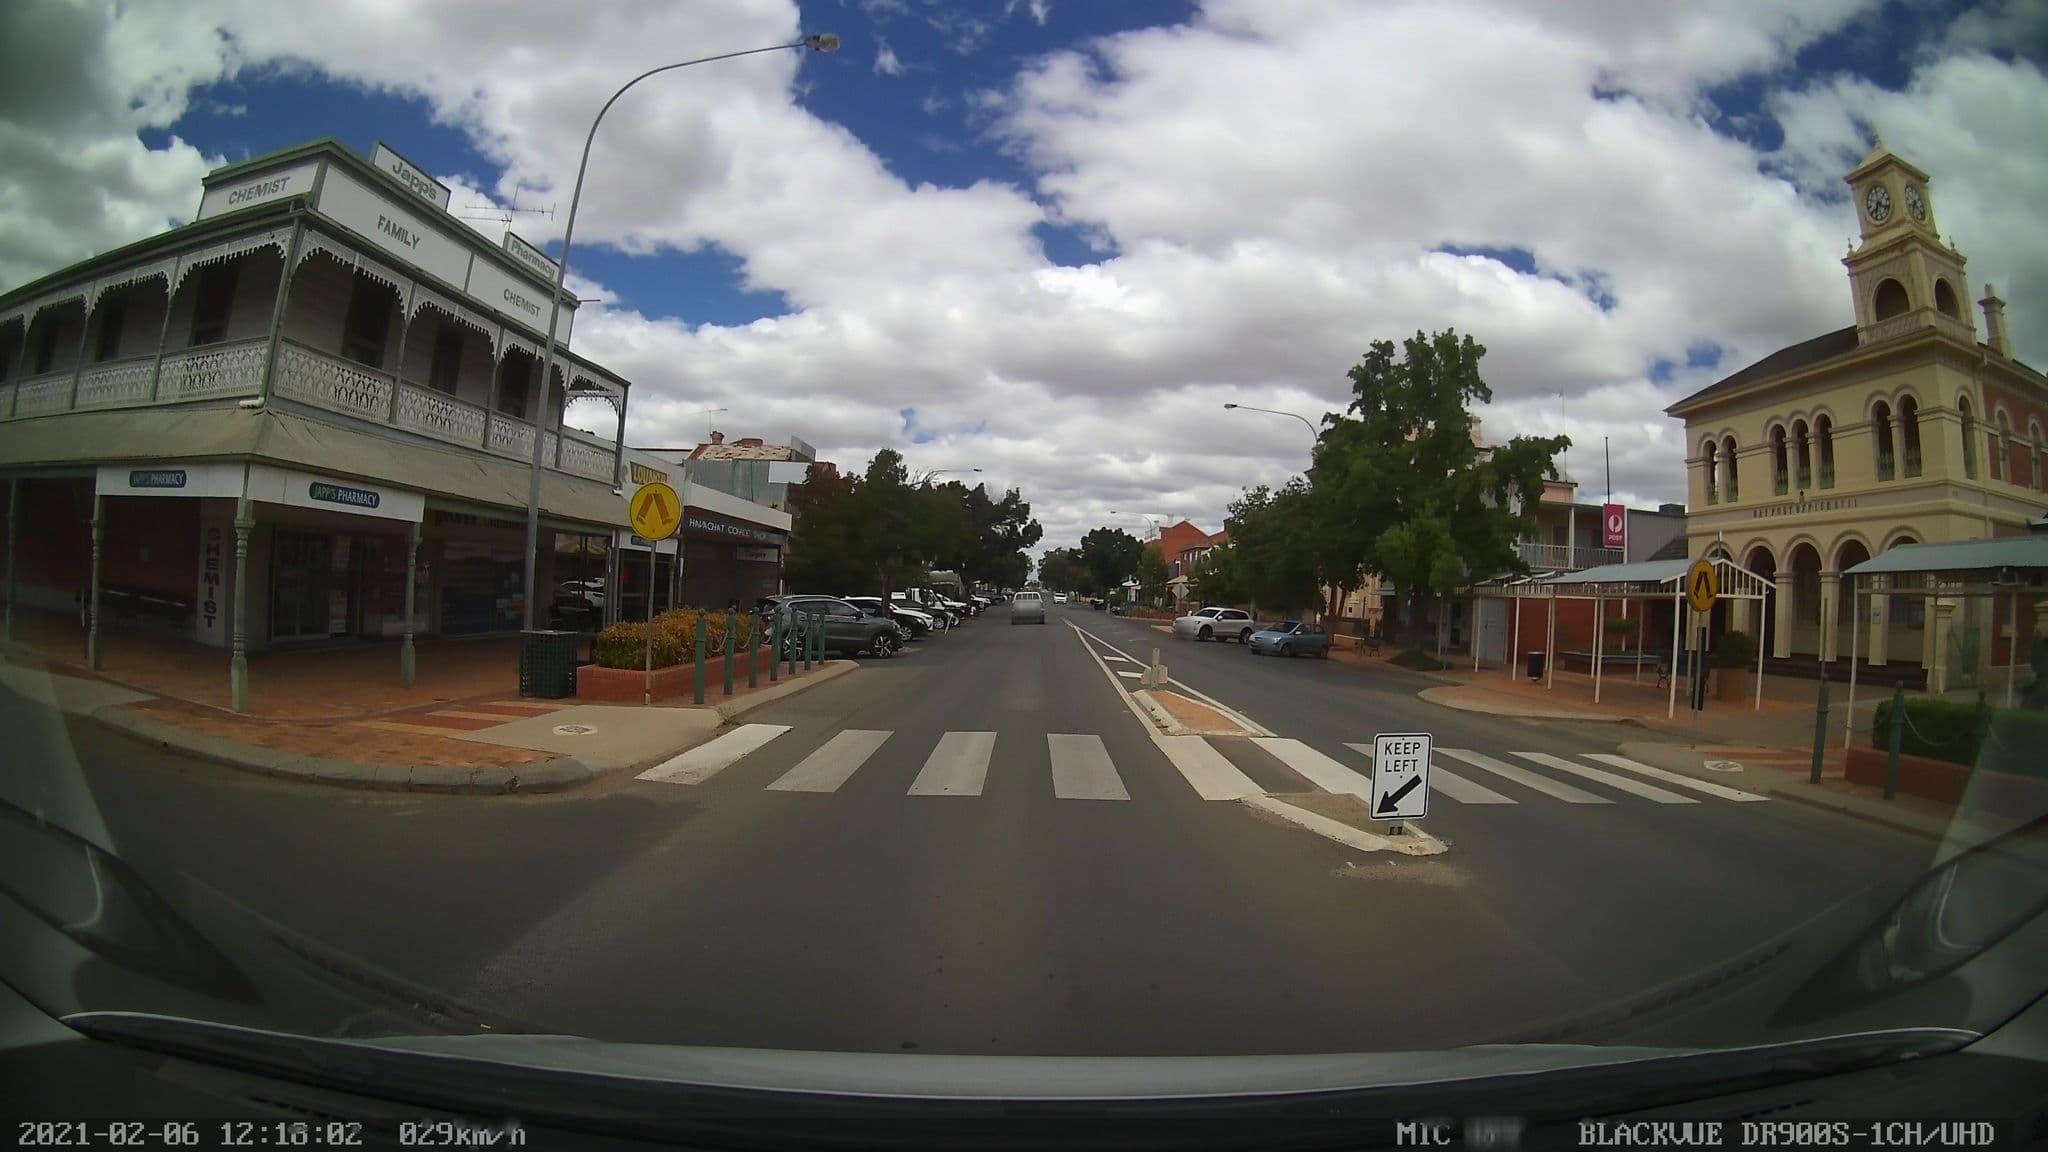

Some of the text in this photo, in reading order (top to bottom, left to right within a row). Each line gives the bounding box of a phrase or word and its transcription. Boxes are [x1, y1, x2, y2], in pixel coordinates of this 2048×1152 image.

[228, 176, 291, 205] CHEMIST
[392, 161, 437, 200] Japp's
[377, 214, 421, 250] FAMILY
[511, 239, 556, 280] Pharmacy
[503, 288, 541, 318] CHEMIST
[150, 472, 185, 486] PHARMACY
[313, 483, 378, 508] JAPP'S PHARMACY
[203, 527, 221, 630] CHEMIST
[1384, 742, 1421, 756] KEEP
[1385, 759, 1418, 773] LEFT
